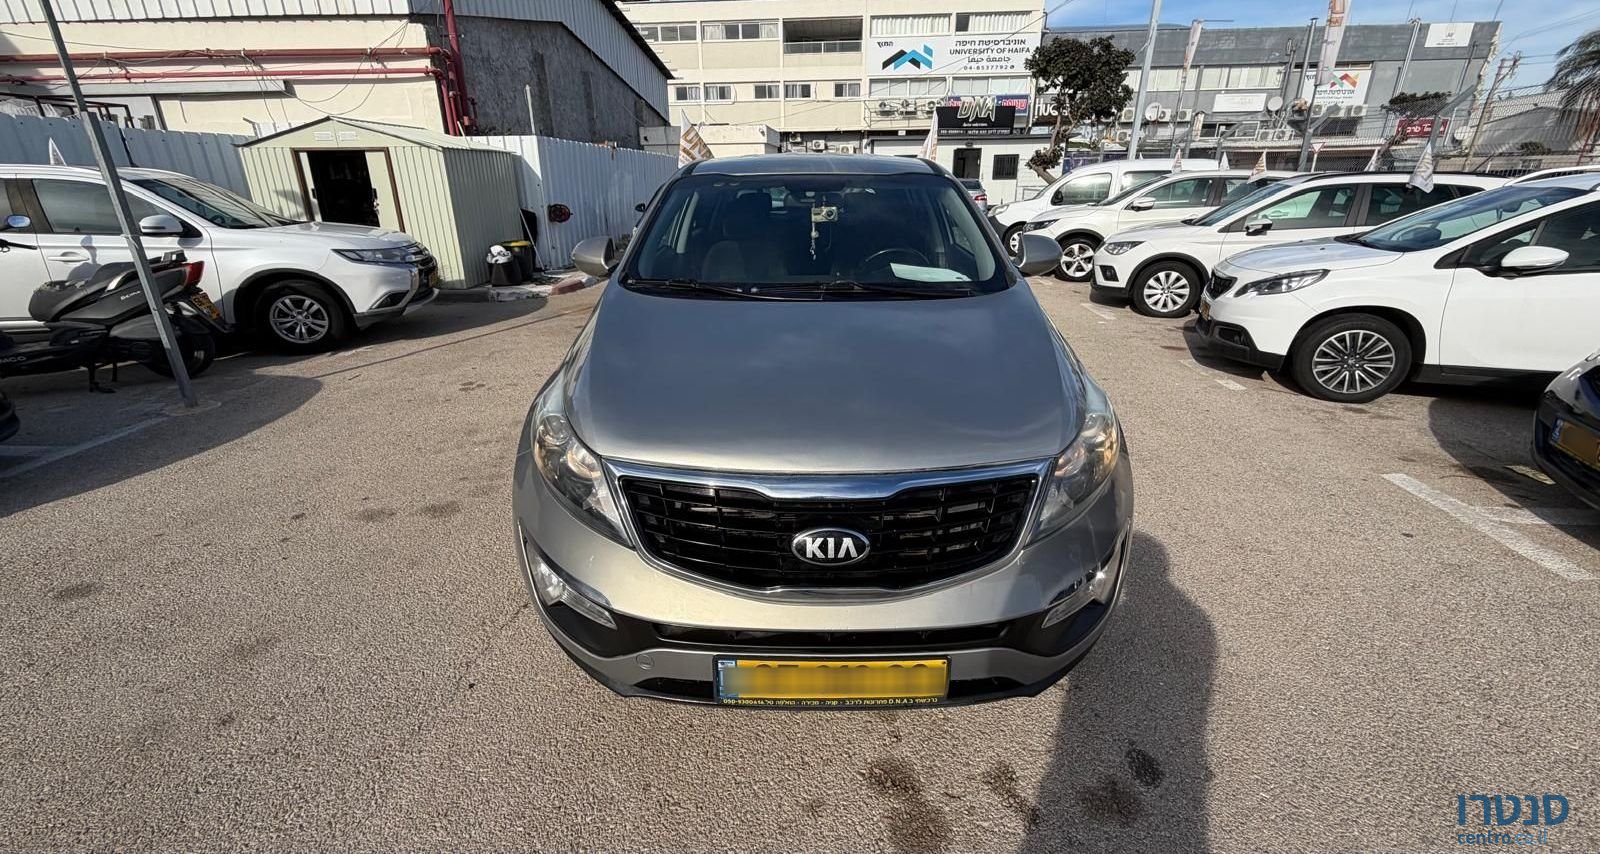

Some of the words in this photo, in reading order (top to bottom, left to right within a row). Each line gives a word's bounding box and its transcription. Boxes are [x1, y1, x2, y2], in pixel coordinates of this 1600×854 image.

[977, 38, 1026, 47] אוניברסיטת
[949, 47, 995, 56] UNIVERSITY
[1008, 46, 1031, 54] HAIFA
[957, 96, 996, 122] DNA
[805, 536, 858, 559] KIA
